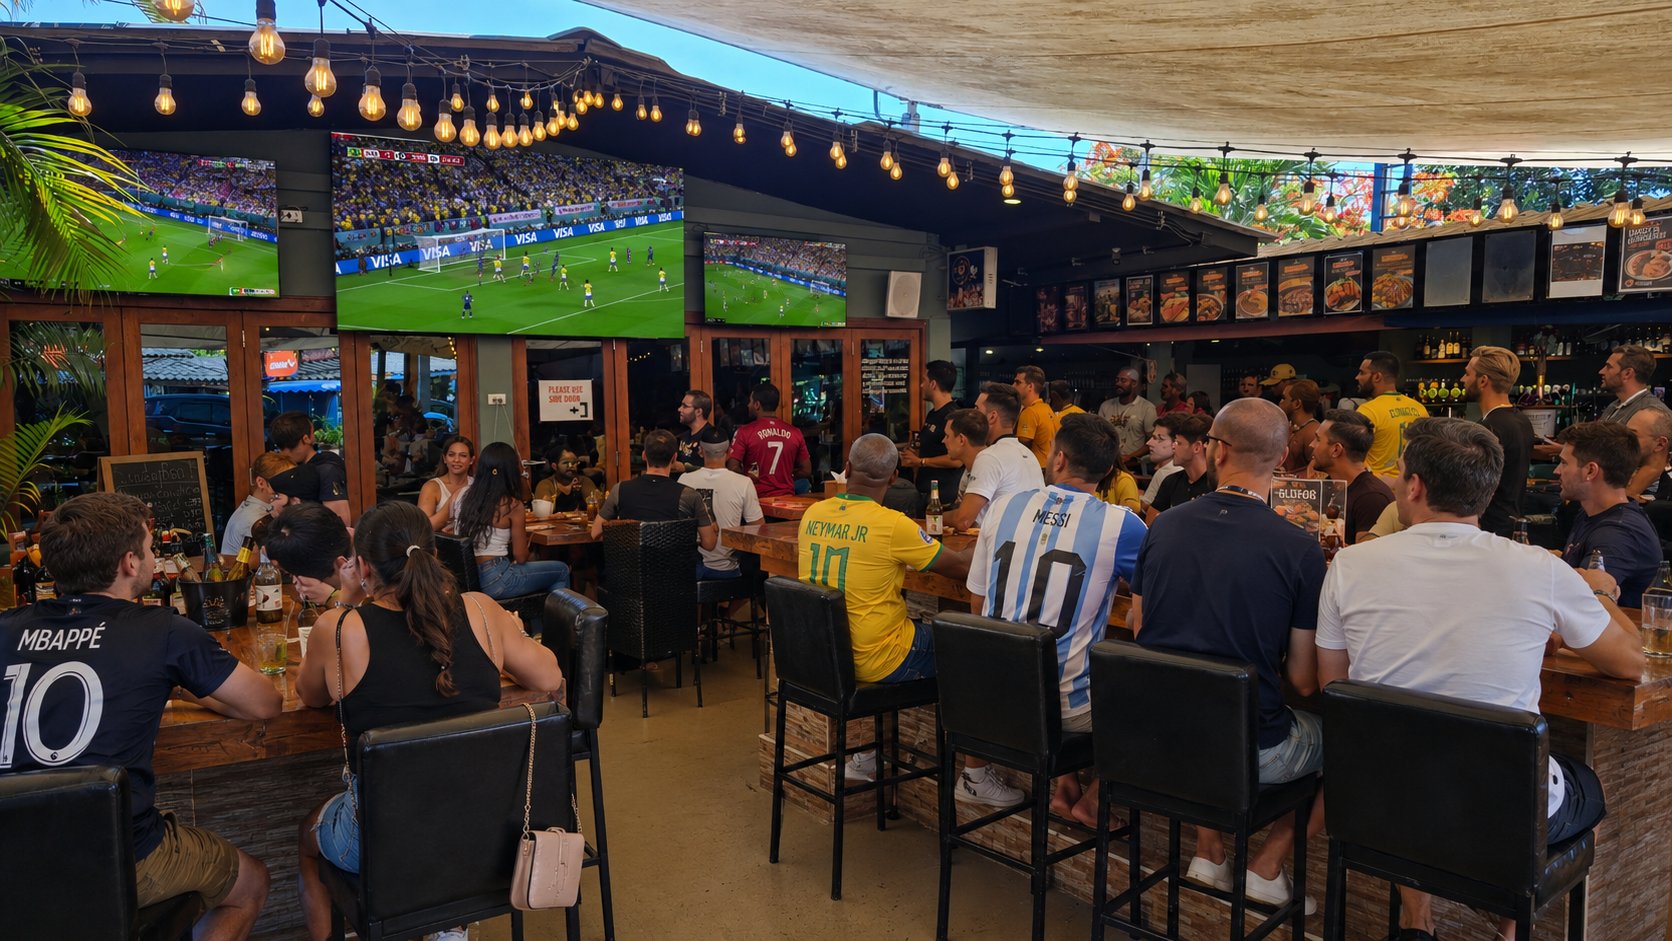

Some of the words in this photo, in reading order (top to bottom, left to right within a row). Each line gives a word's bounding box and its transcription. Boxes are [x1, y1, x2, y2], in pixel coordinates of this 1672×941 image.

[553, 226, 574, 239] VISA
[588, 221, 606, 233] VISA
[515, 232, 537, 245] VISA
[371, 253, 402, 269] VISA
[422, 245, 451, 260] VISA
[757, 427, 791, 440] RONALDO
[767, 441, 784, 475] 7
[1032, 509, 1071, 528] MESSI
[805, 520, 851, 540] NEYMAR
[851, 525, 868, 543] JR
[809, 542, 850, 593] 10
[988, 540, 1087, 640] 10
[17, 621, 106, 651] MBAPPÉ
[0, 661, 104, 768] 10
